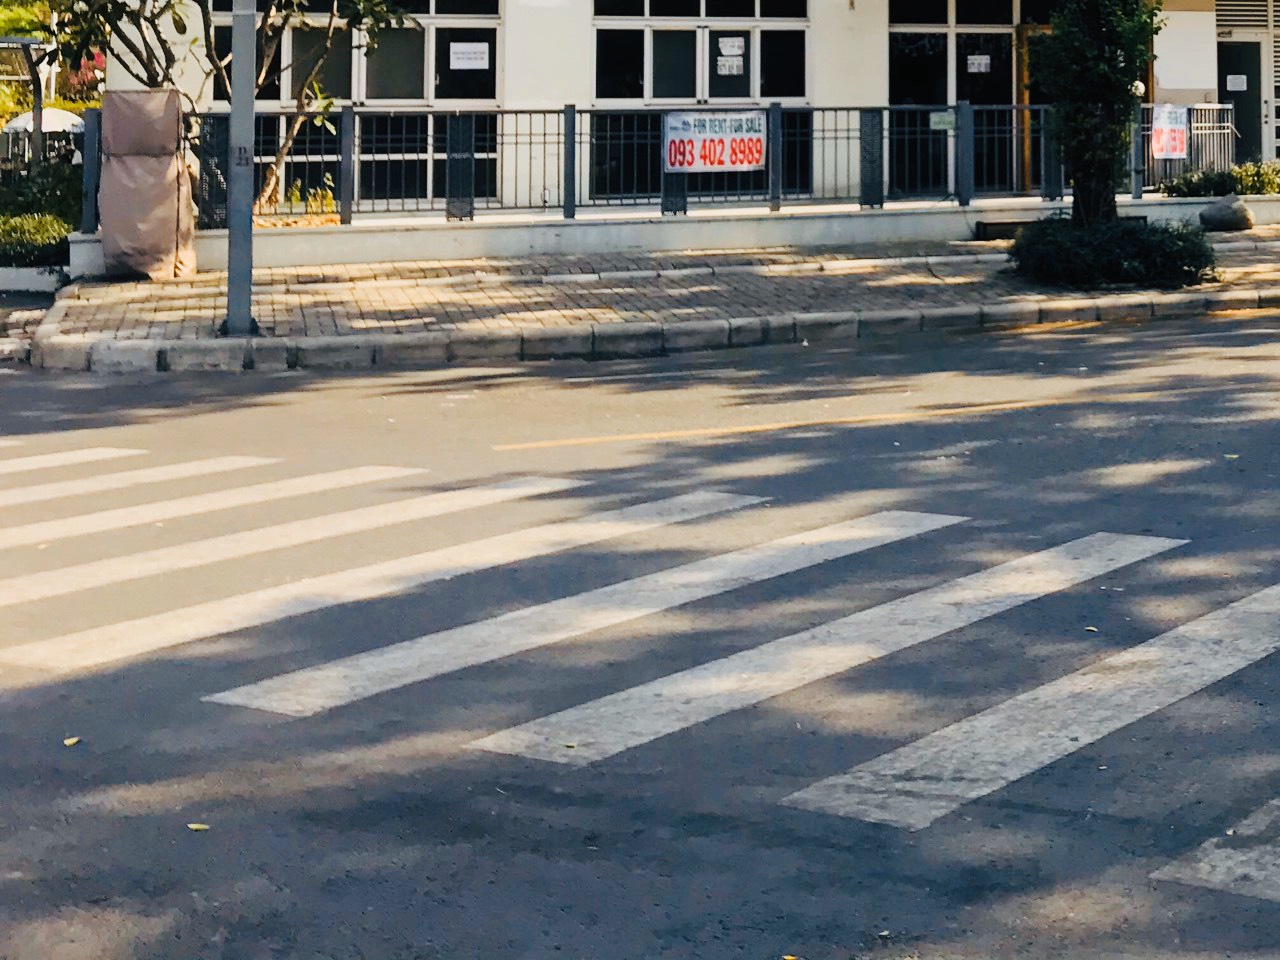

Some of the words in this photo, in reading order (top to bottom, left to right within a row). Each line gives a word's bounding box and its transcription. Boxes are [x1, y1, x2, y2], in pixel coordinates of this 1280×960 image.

[693, 118, 707, 134] FOR
[745, 117, 763, 134] SALE
[668, 138, 695, 167] 093
[699, 138, 725, 166] 402
[729, 137, 763, 166] 8989
